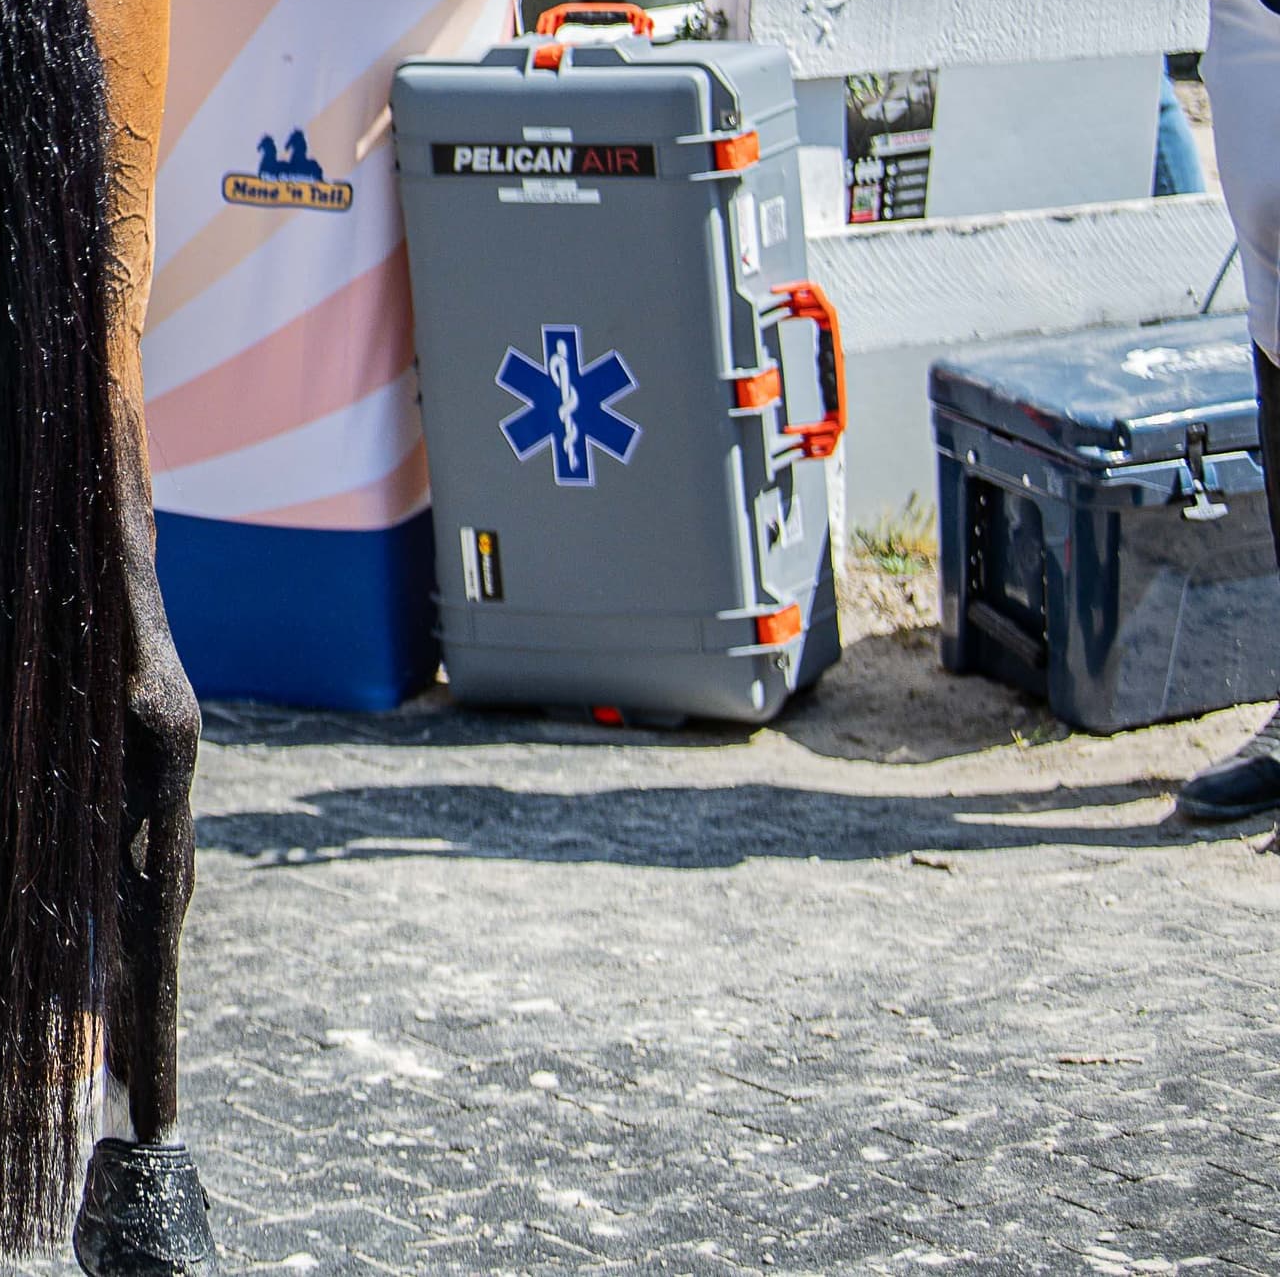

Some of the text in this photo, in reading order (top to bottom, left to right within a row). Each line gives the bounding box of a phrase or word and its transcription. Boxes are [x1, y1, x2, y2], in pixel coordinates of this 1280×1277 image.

[453, 146, 640, 173] PELICAN AIR
[232, 179, 280, 200] Mane
[310, 187, 344, 205] Tail
